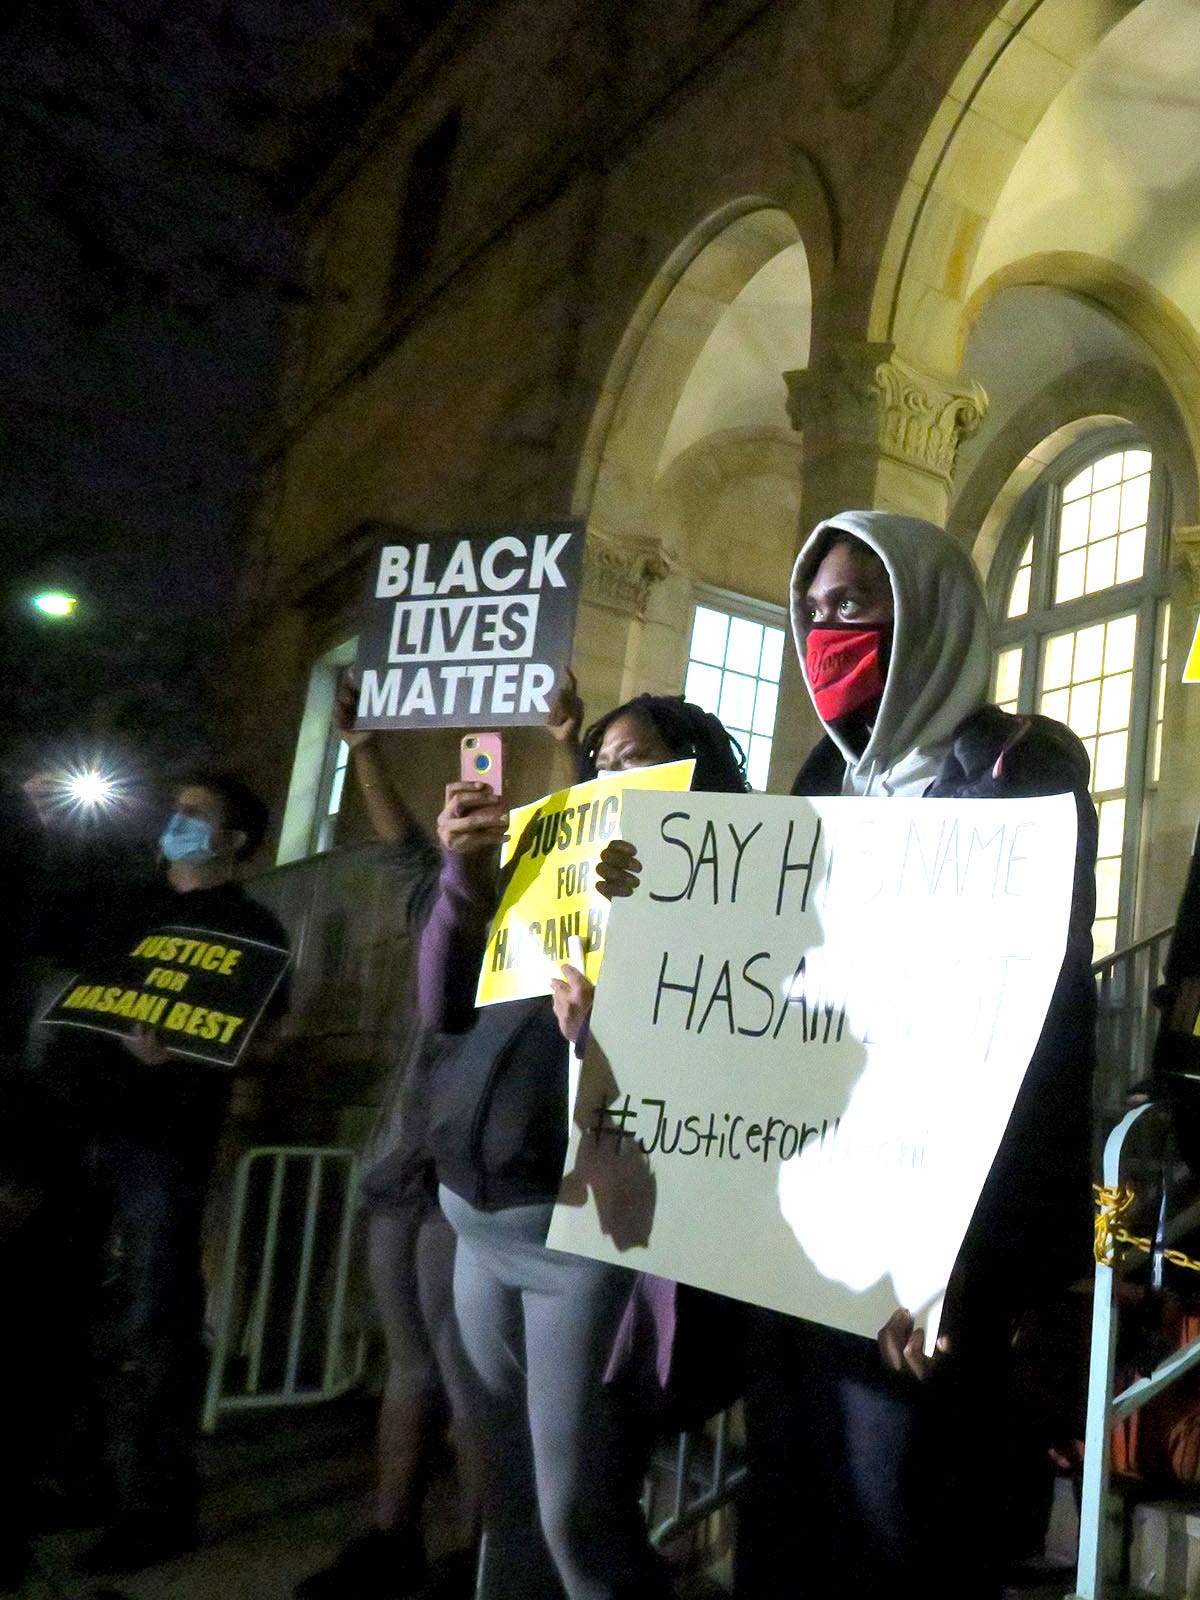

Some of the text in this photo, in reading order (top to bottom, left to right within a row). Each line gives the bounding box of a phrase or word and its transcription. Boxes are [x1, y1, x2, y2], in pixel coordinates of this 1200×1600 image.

[375, 533, 572, 599] BLACK
[396, 602, 529, 655] LIVES
[357, 663, 555, 718] MATTER
[530, 795, 620, 859] JUSTIC
[557, 860, 590, 900] FOR
[649, 811, 764, 905] SAY
[897, 817, 1036, 898] NAME
[129, 934, 245, 977] JUSTICE
[144, 966, 190, 993] FOR
[61, 984, 246, 1045] HASANI BEST
